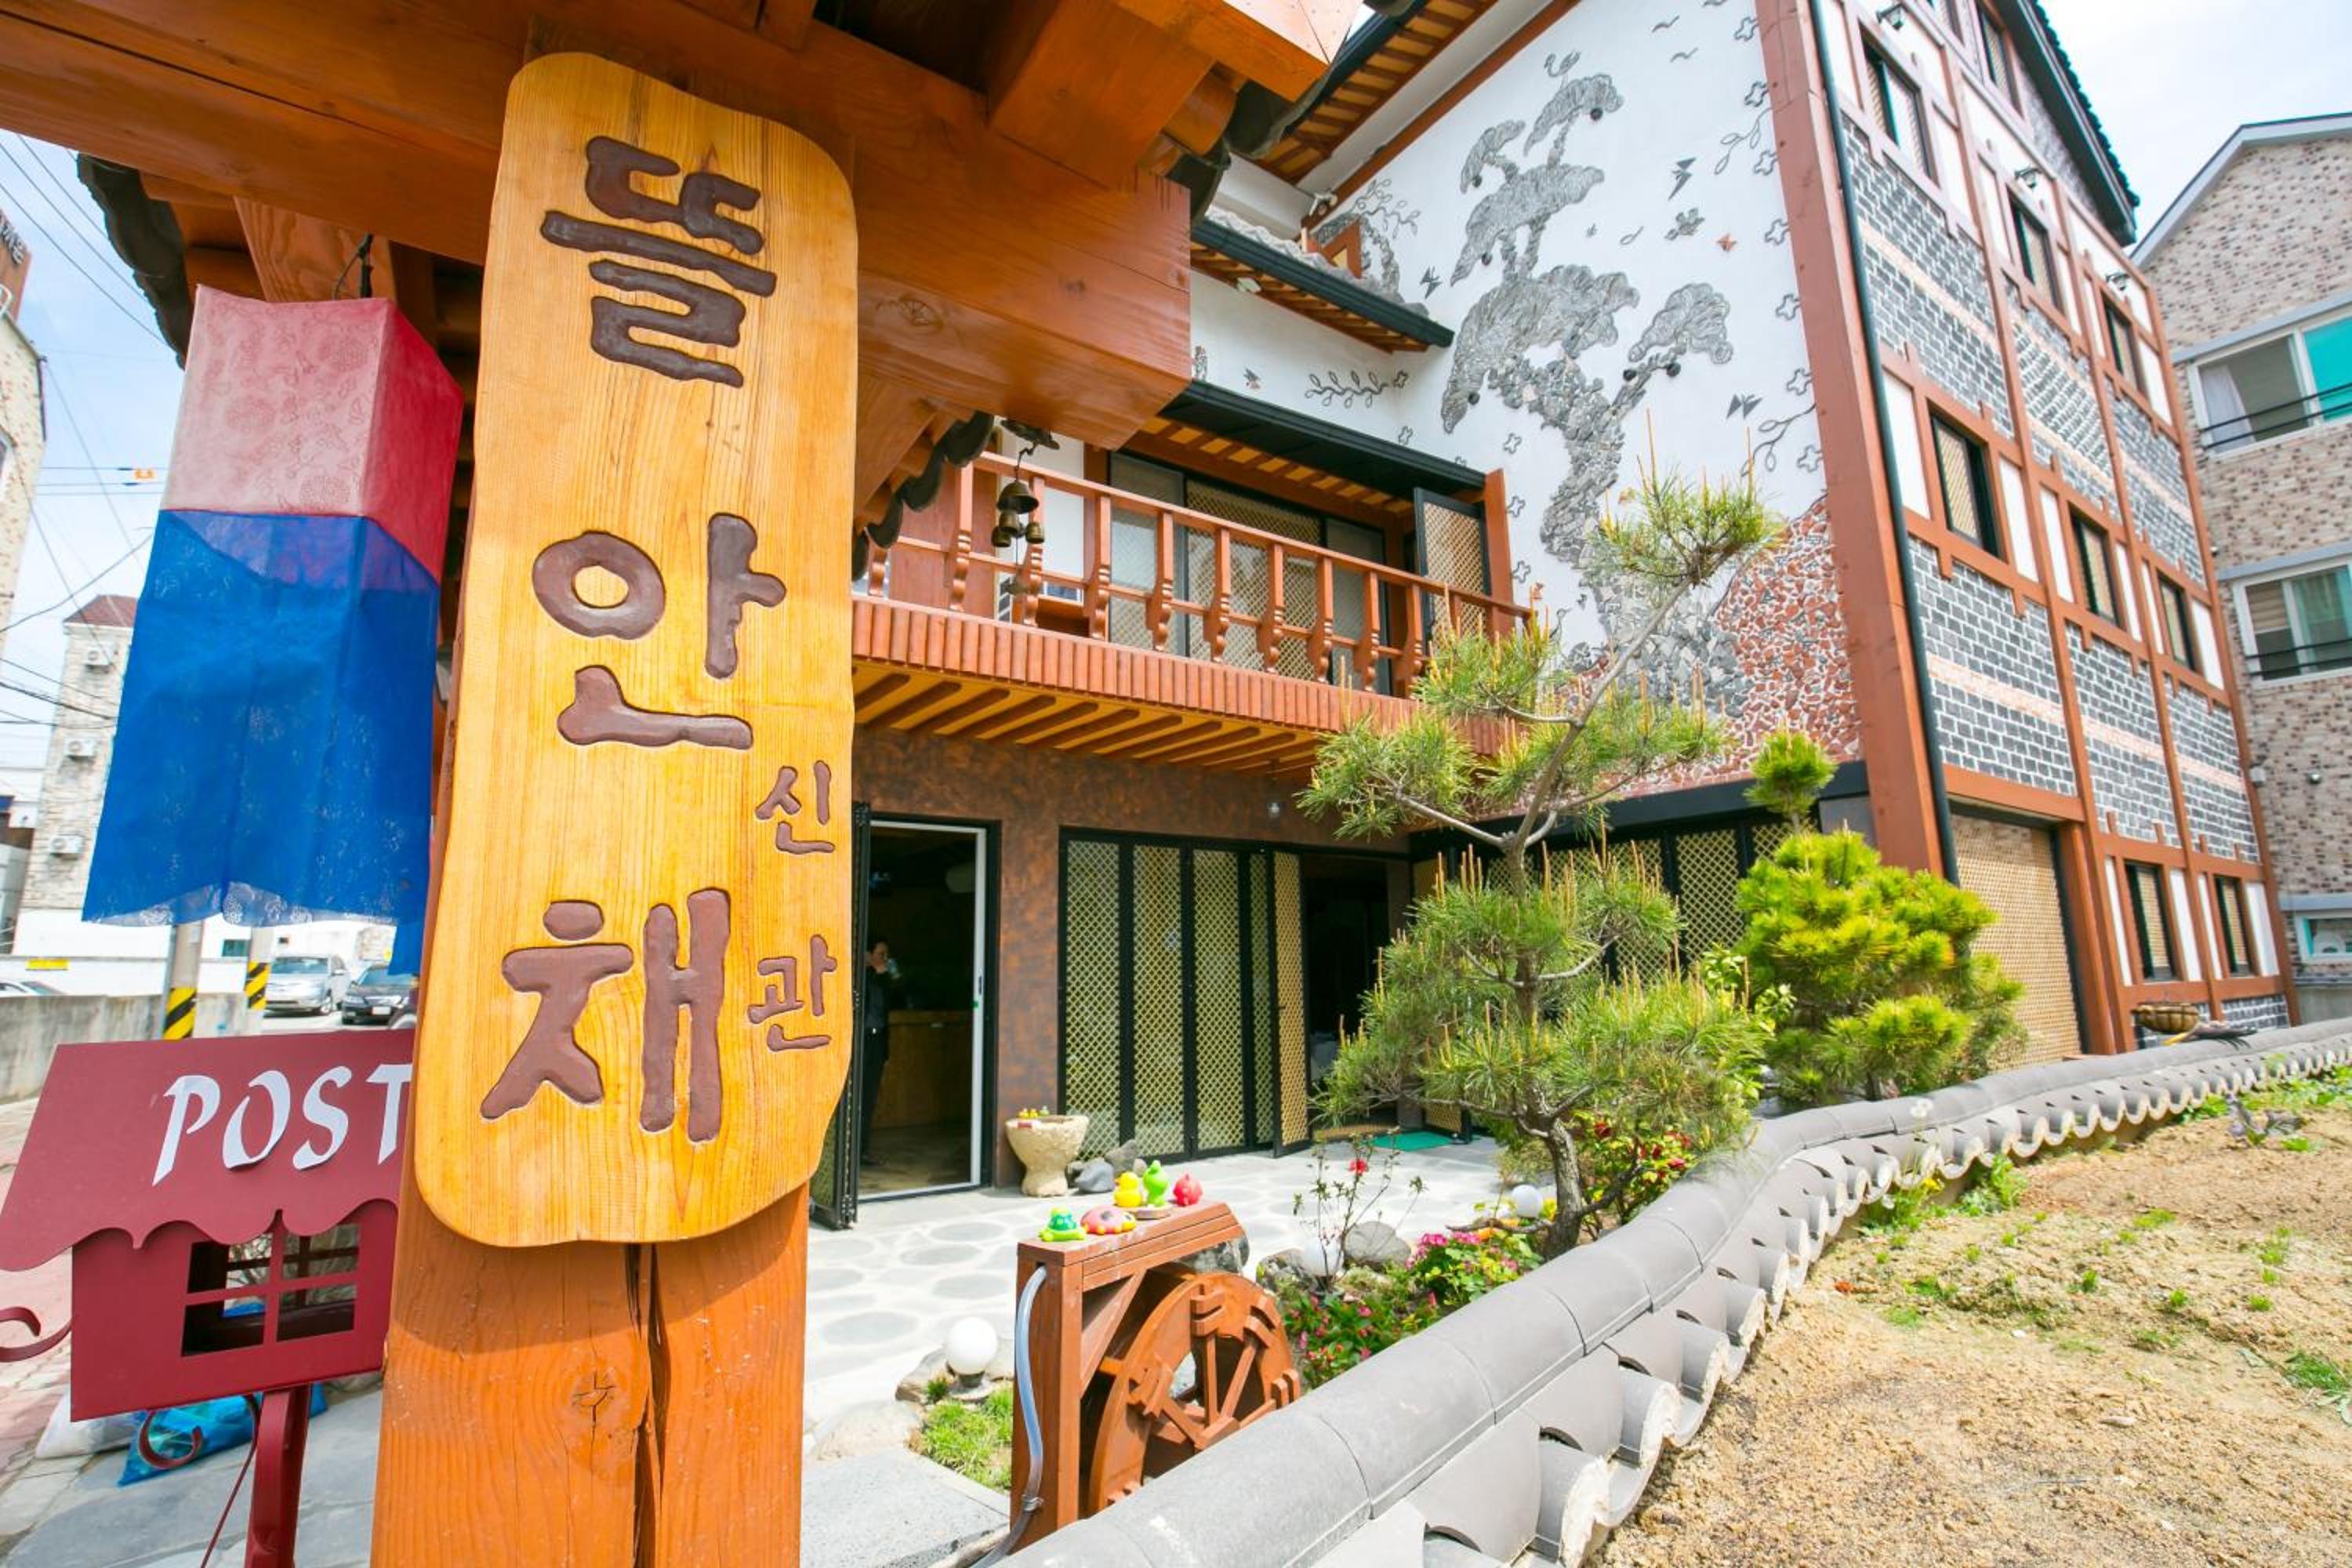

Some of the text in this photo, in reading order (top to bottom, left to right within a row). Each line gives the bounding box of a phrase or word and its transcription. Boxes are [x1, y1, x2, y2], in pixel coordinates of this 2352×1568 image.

[479, 136, 786, 1143] 뜰안채
[747, 760, 837, 1051] 신관
[152, 1063, 412, 1186] POST
